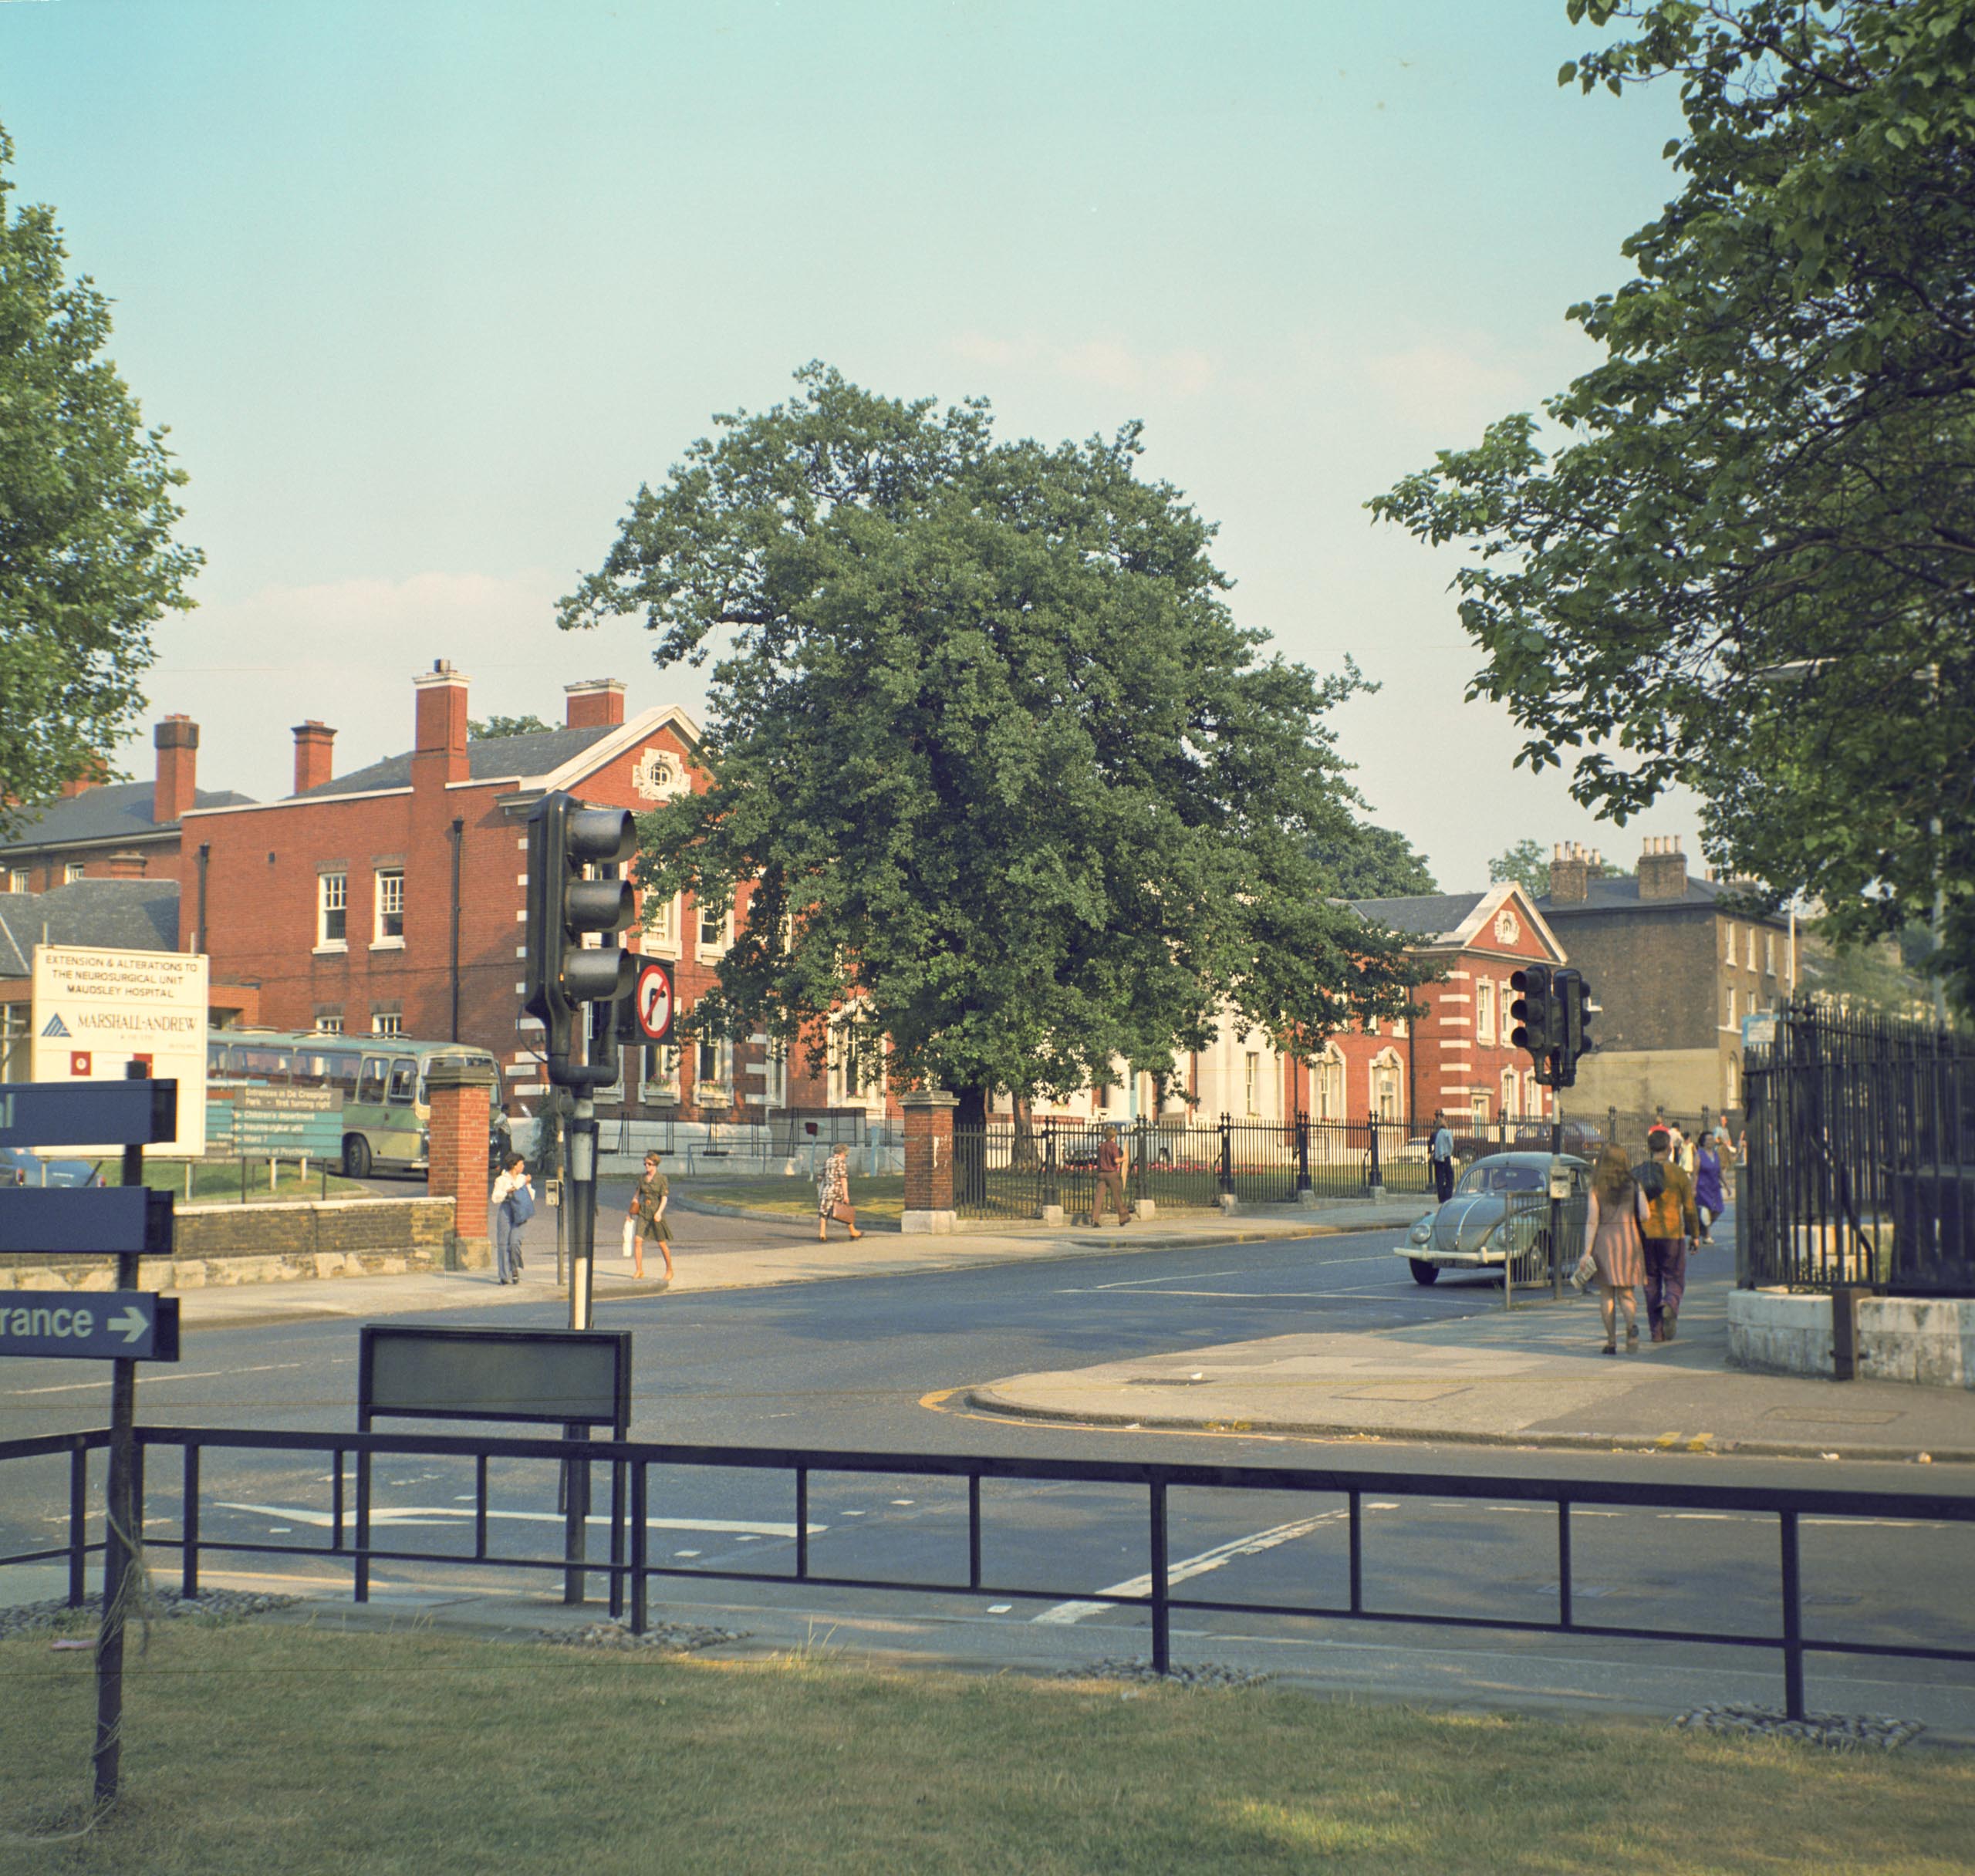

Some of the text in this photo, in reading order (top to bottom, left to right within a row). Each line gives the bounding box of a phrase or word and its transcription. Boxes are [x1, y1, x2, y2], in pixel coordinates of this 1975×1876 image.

[46, 955, 198, 972] EXTENSION & ALTERATIONS TO
[52, 969, 184, 985] THE NEUROSURGICAL UNIT
[67, 984, 174, 998] MAUDSLEY HOSPITAL
[286, 1089, 296, 1098] De
